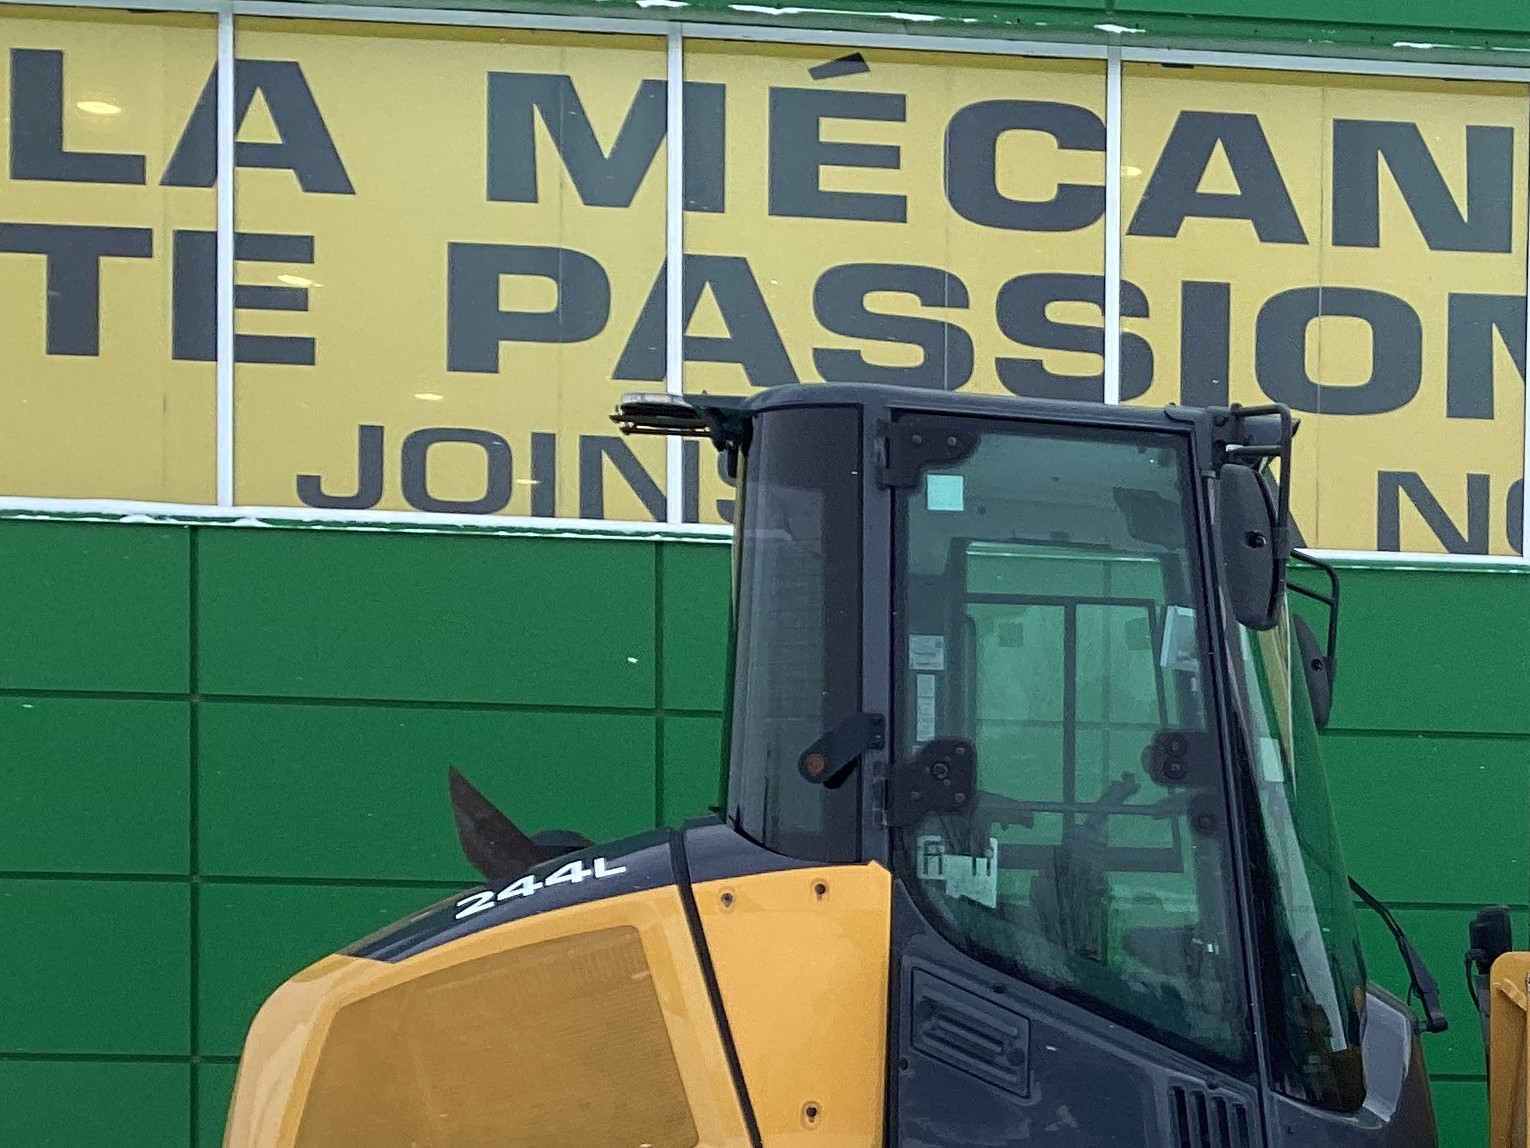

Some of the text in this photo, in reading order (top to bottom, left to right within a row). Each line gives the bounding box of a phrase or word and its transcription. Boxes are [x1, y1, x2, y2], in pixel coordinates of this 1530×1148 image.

[10, 48, 356, 196] LA
[0, 222, 316, 366] TE
[296, 424, 737, 524] JOIN
[455, 857, 627, 920] 244L
